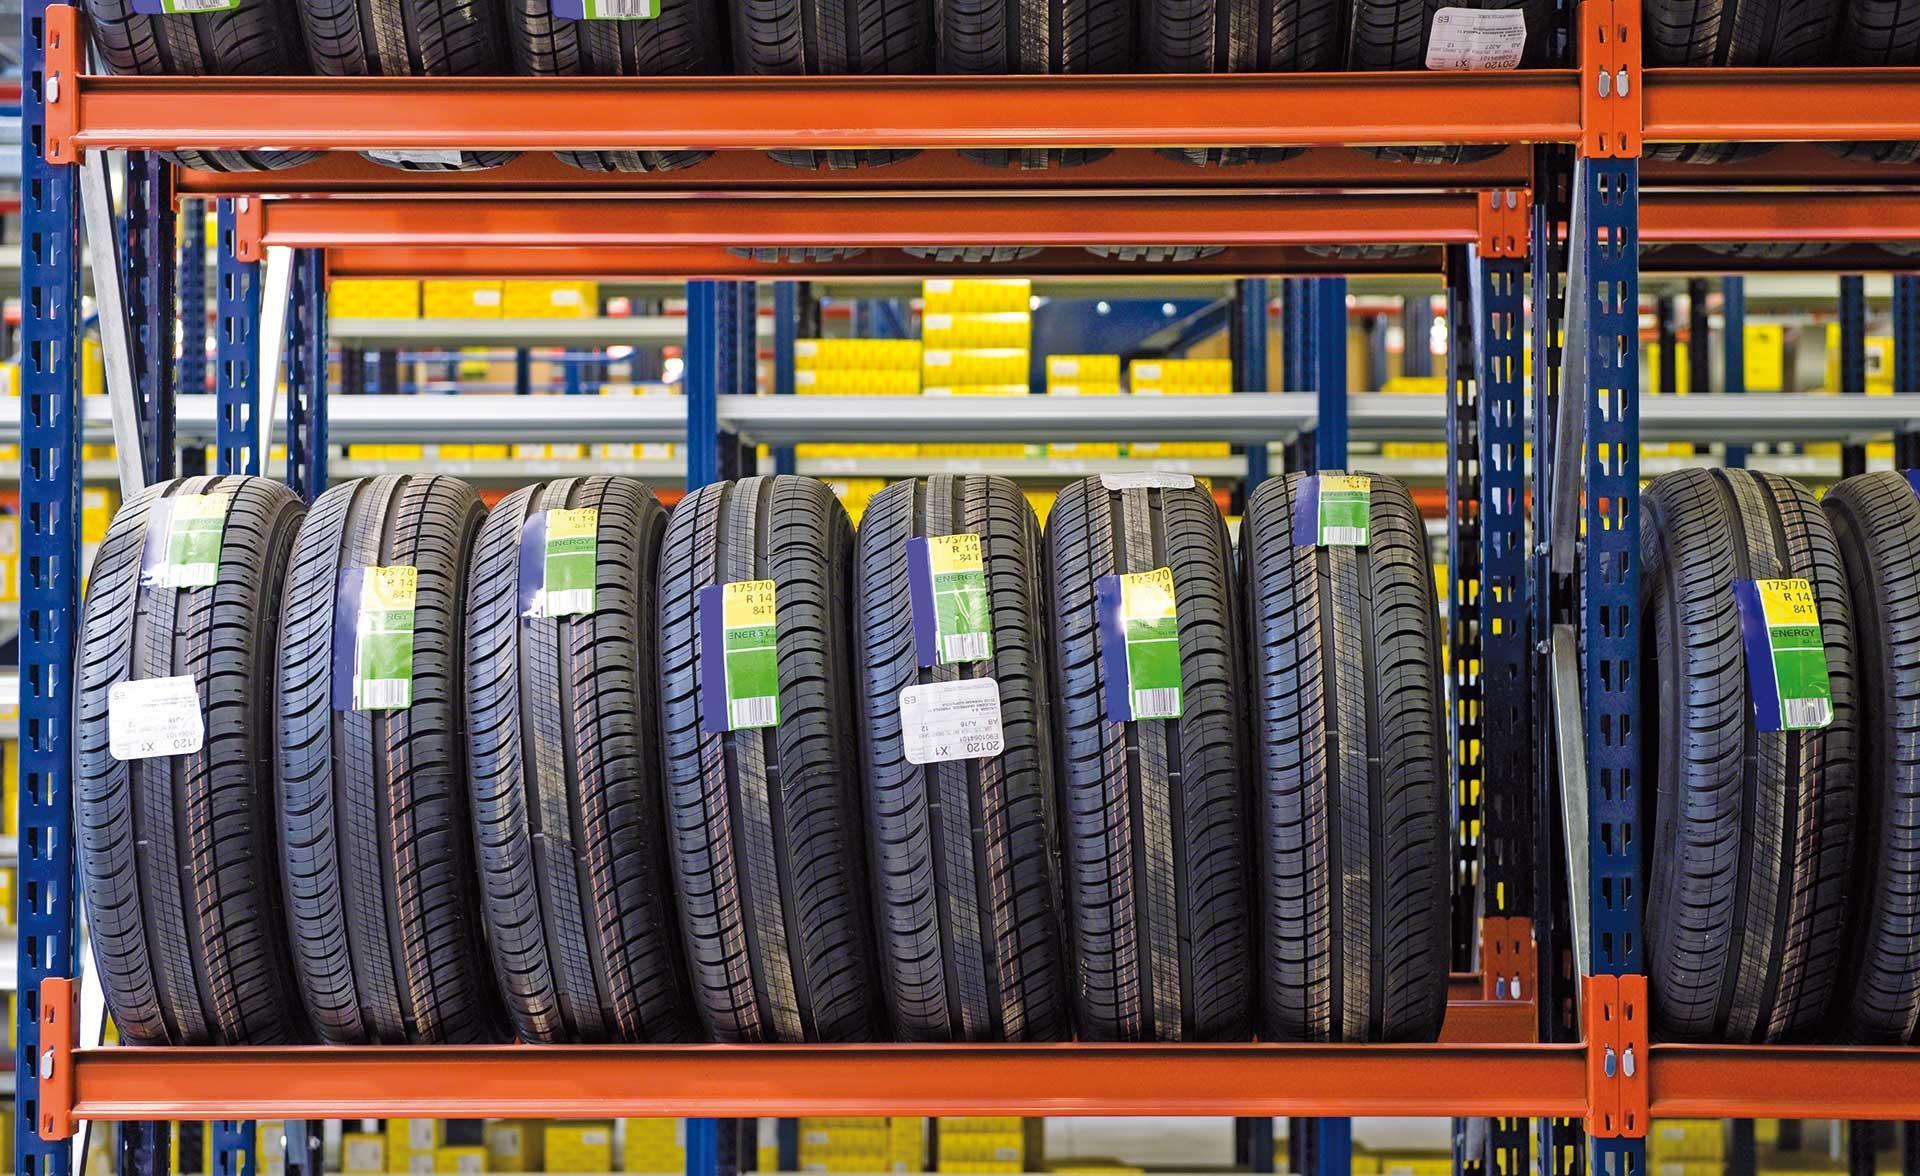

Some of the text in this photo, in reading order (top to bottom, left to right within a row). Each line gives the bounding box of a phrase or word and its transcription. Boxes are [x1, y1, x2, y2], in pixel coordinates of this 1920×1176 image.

[938, 534, 977, 545] 175/70
[952, 543, 978, 553] R 14
[935, 573, 979, 583] ENERGY
[732, 581, 773, 593] 175/70
[1766, 580, 1808, 591] 175/70
[746, 593, 772, 604] R 14
[1783, 592, 1811, 602] R 14
[727, 628, 771, 640] ENERGY
[1771, 628, 1815, 638] ENERGY
[904, 695, 917, 705] ES
[141, 741, 154, 752] X1
[935, 745, 949, 756] X1
[966, 741, 1000, 753] 20120
